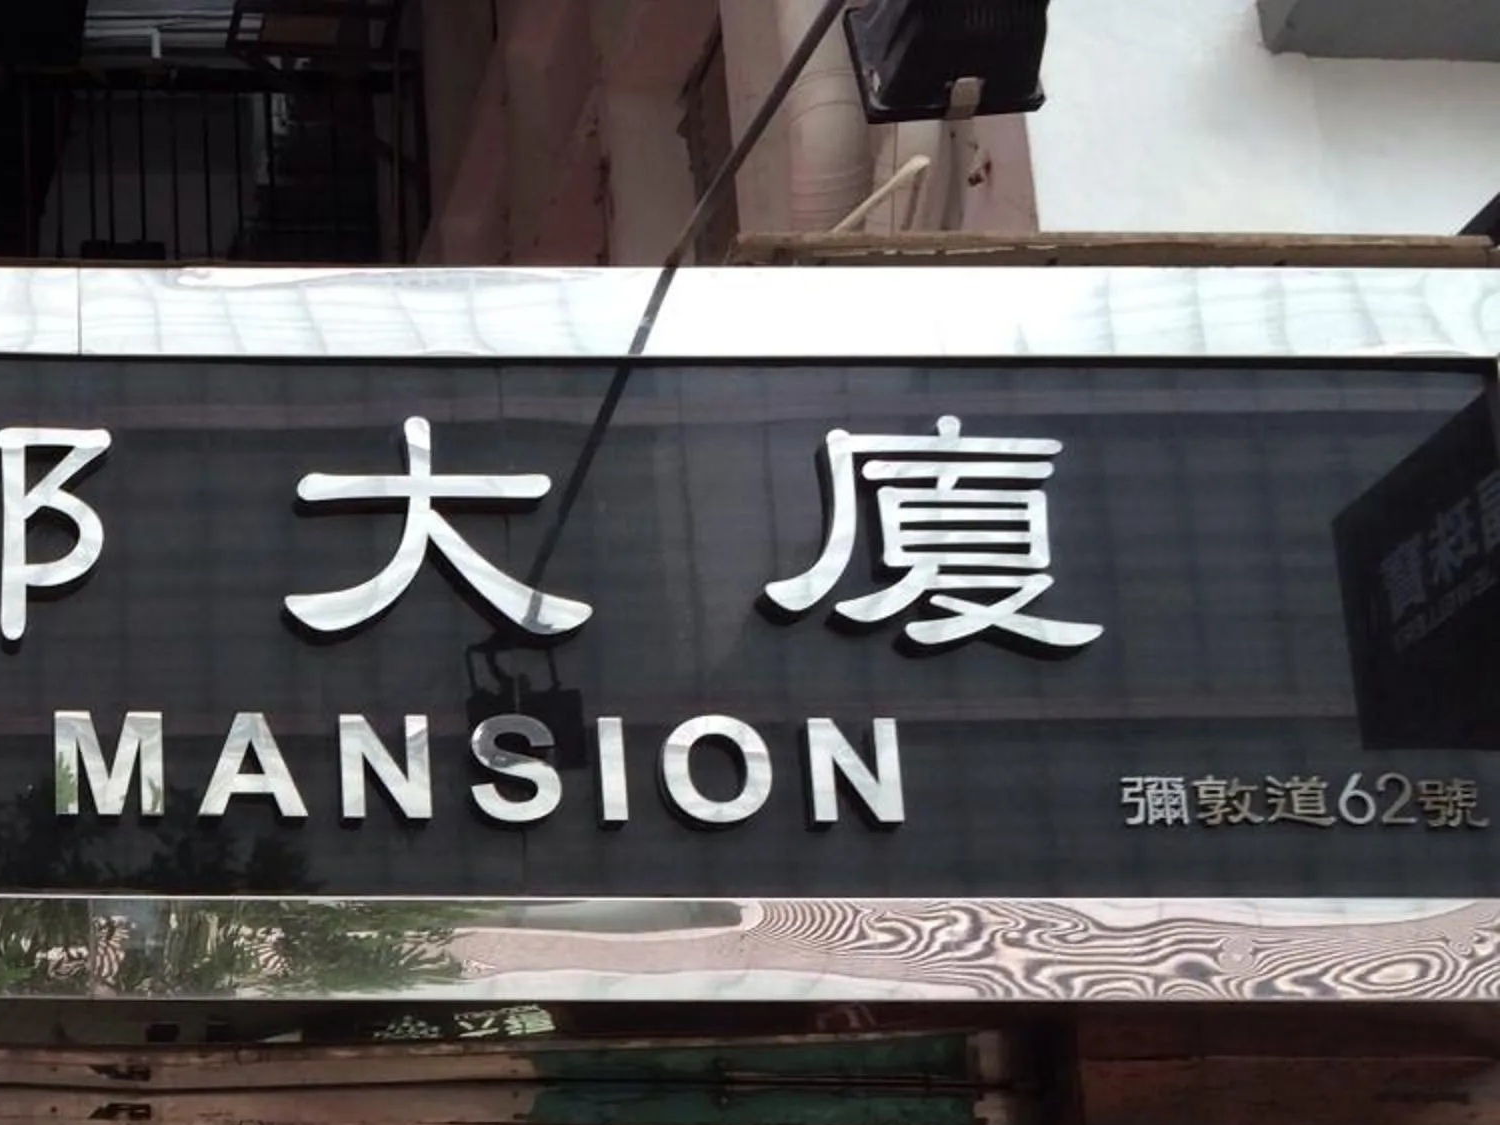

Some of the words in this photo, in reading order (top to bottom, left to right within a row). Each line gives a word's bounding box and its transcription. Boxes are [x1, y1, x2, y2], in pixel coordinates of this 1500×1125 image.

[54, 709, 906, 824] MANSION
[1119, 771, 1491, 828] 彌敦道62號
